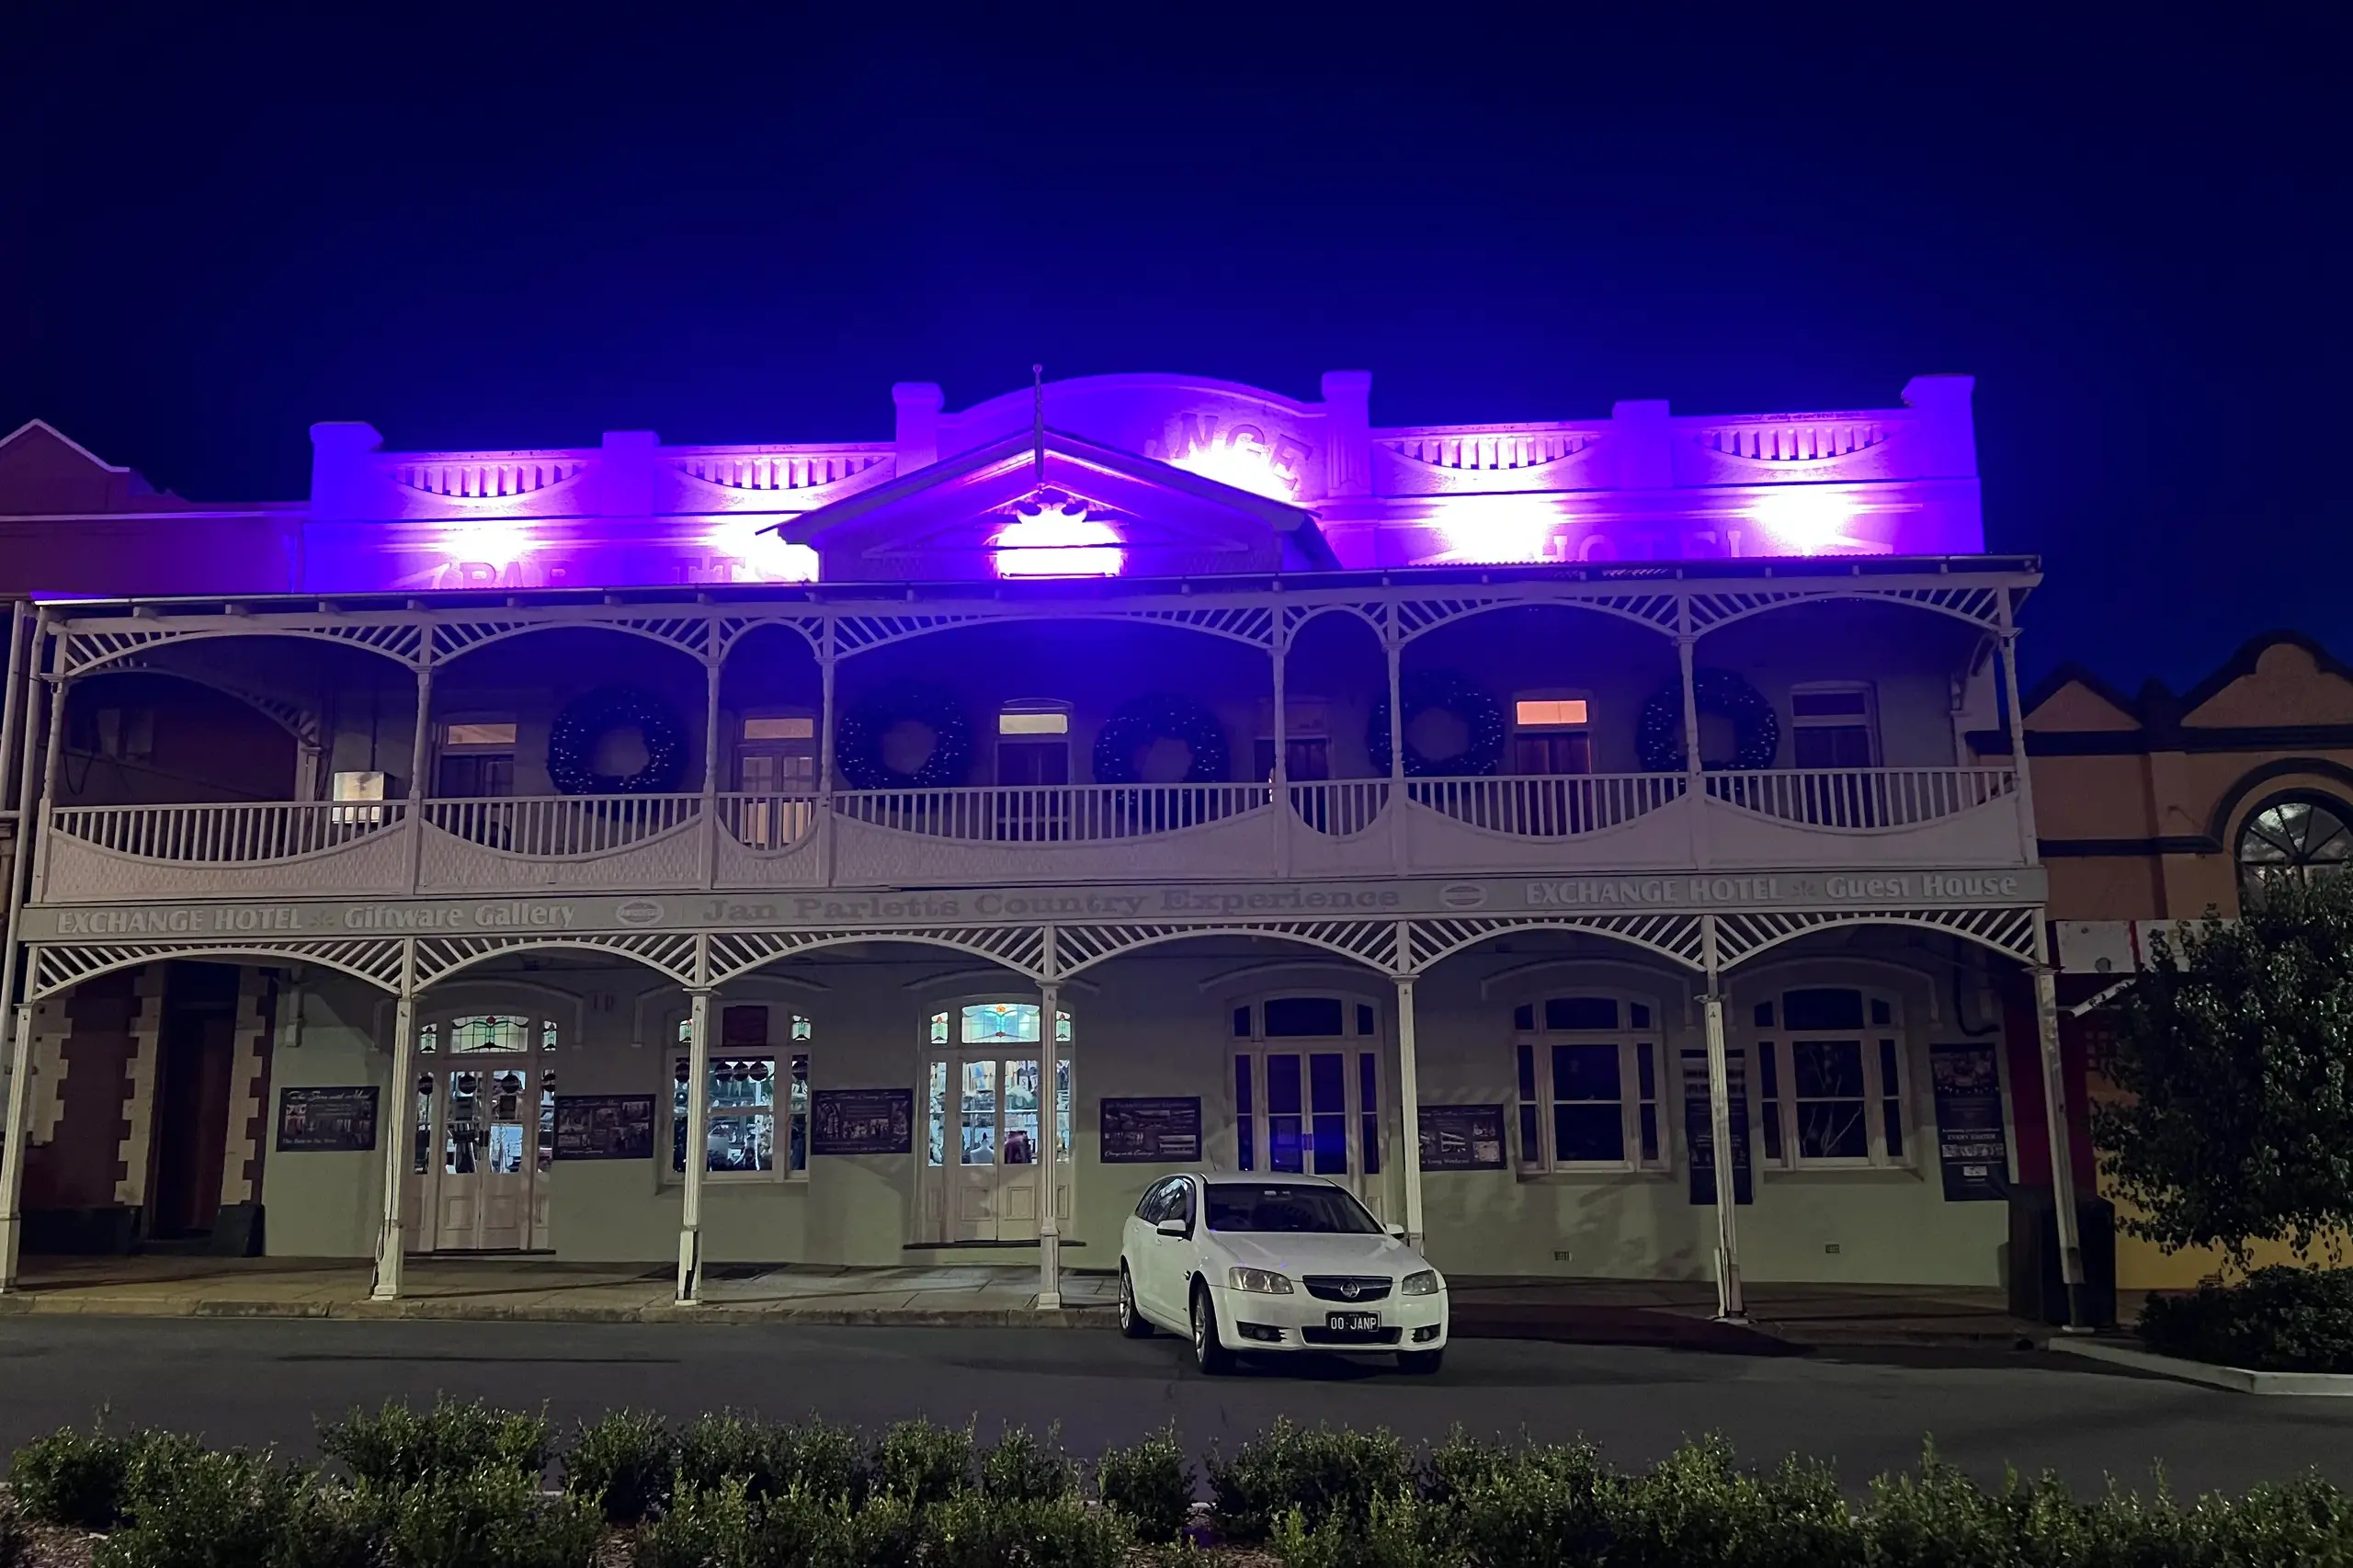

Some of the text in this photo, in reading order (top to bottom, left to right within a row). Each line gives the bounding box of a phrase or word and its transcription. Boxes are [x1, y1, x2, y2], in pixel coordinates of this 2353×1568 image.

[702, 898, 778, 922] Jan
[973, 892, 1150, 917] Country
[1160, 886, 1400, 916] Experience
[1525, 874, 2018, 906] EXCHANGE HOTEL Guest House
[56, 899, 576, 936] EXCHANGE HOTEL Giftware Gallery
[1349, 1316, 1377, 1330] JANP
